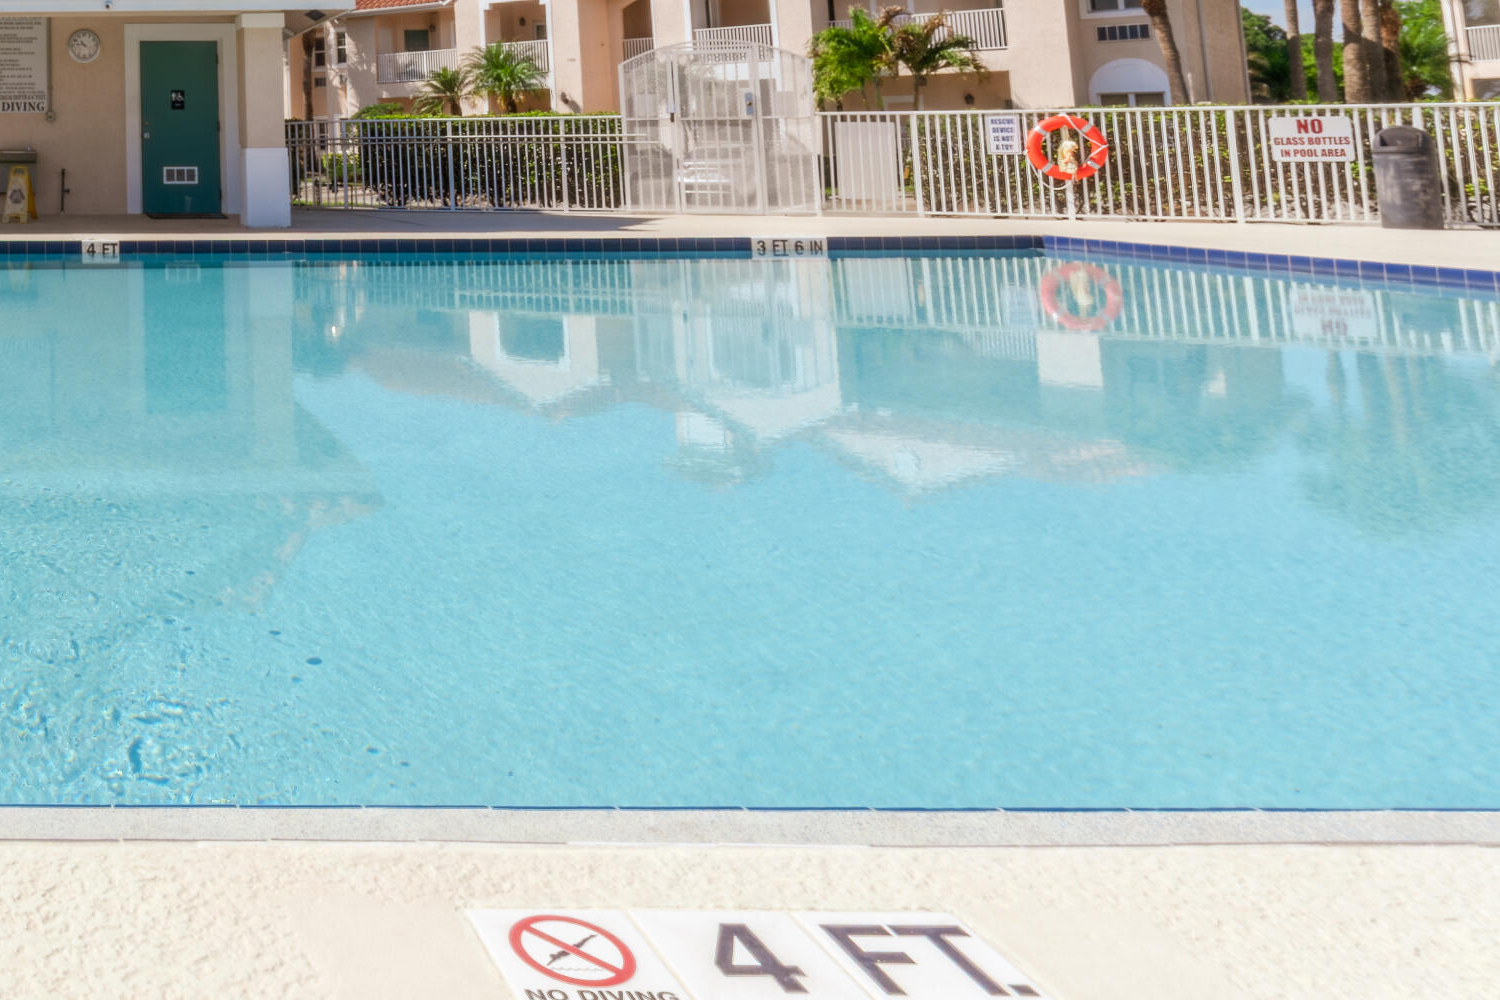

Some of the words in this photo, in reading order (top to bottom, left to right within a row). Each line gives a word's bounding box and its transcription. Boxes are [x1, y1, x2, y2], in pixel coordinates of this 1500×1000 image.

[2, 101, 45, 112] DIVING
[1296, 118, 1323, 134] NO
[1273, 137, 1305, 146] GLASS
[1307, 136, 1350, 145] BOTTLES
[1280, 149, 1291, 157] IN
[1293, 149, 1319, 157] POOL
[1321, 148, 1347, 157] AREA
[86, 243, 96, 257] 4
[102, 243, 118, 258] FT
[756, 240, 766, 256] 3
[794, 240, 804, 255] 6
[810, 240, 824, 255] IN
[714, 922, 809, 994] 4
[818, 923, 1042, 996] FT.
[524, 988, 569, 1000] NO
[577, 989, 680, 1000] DIVING
